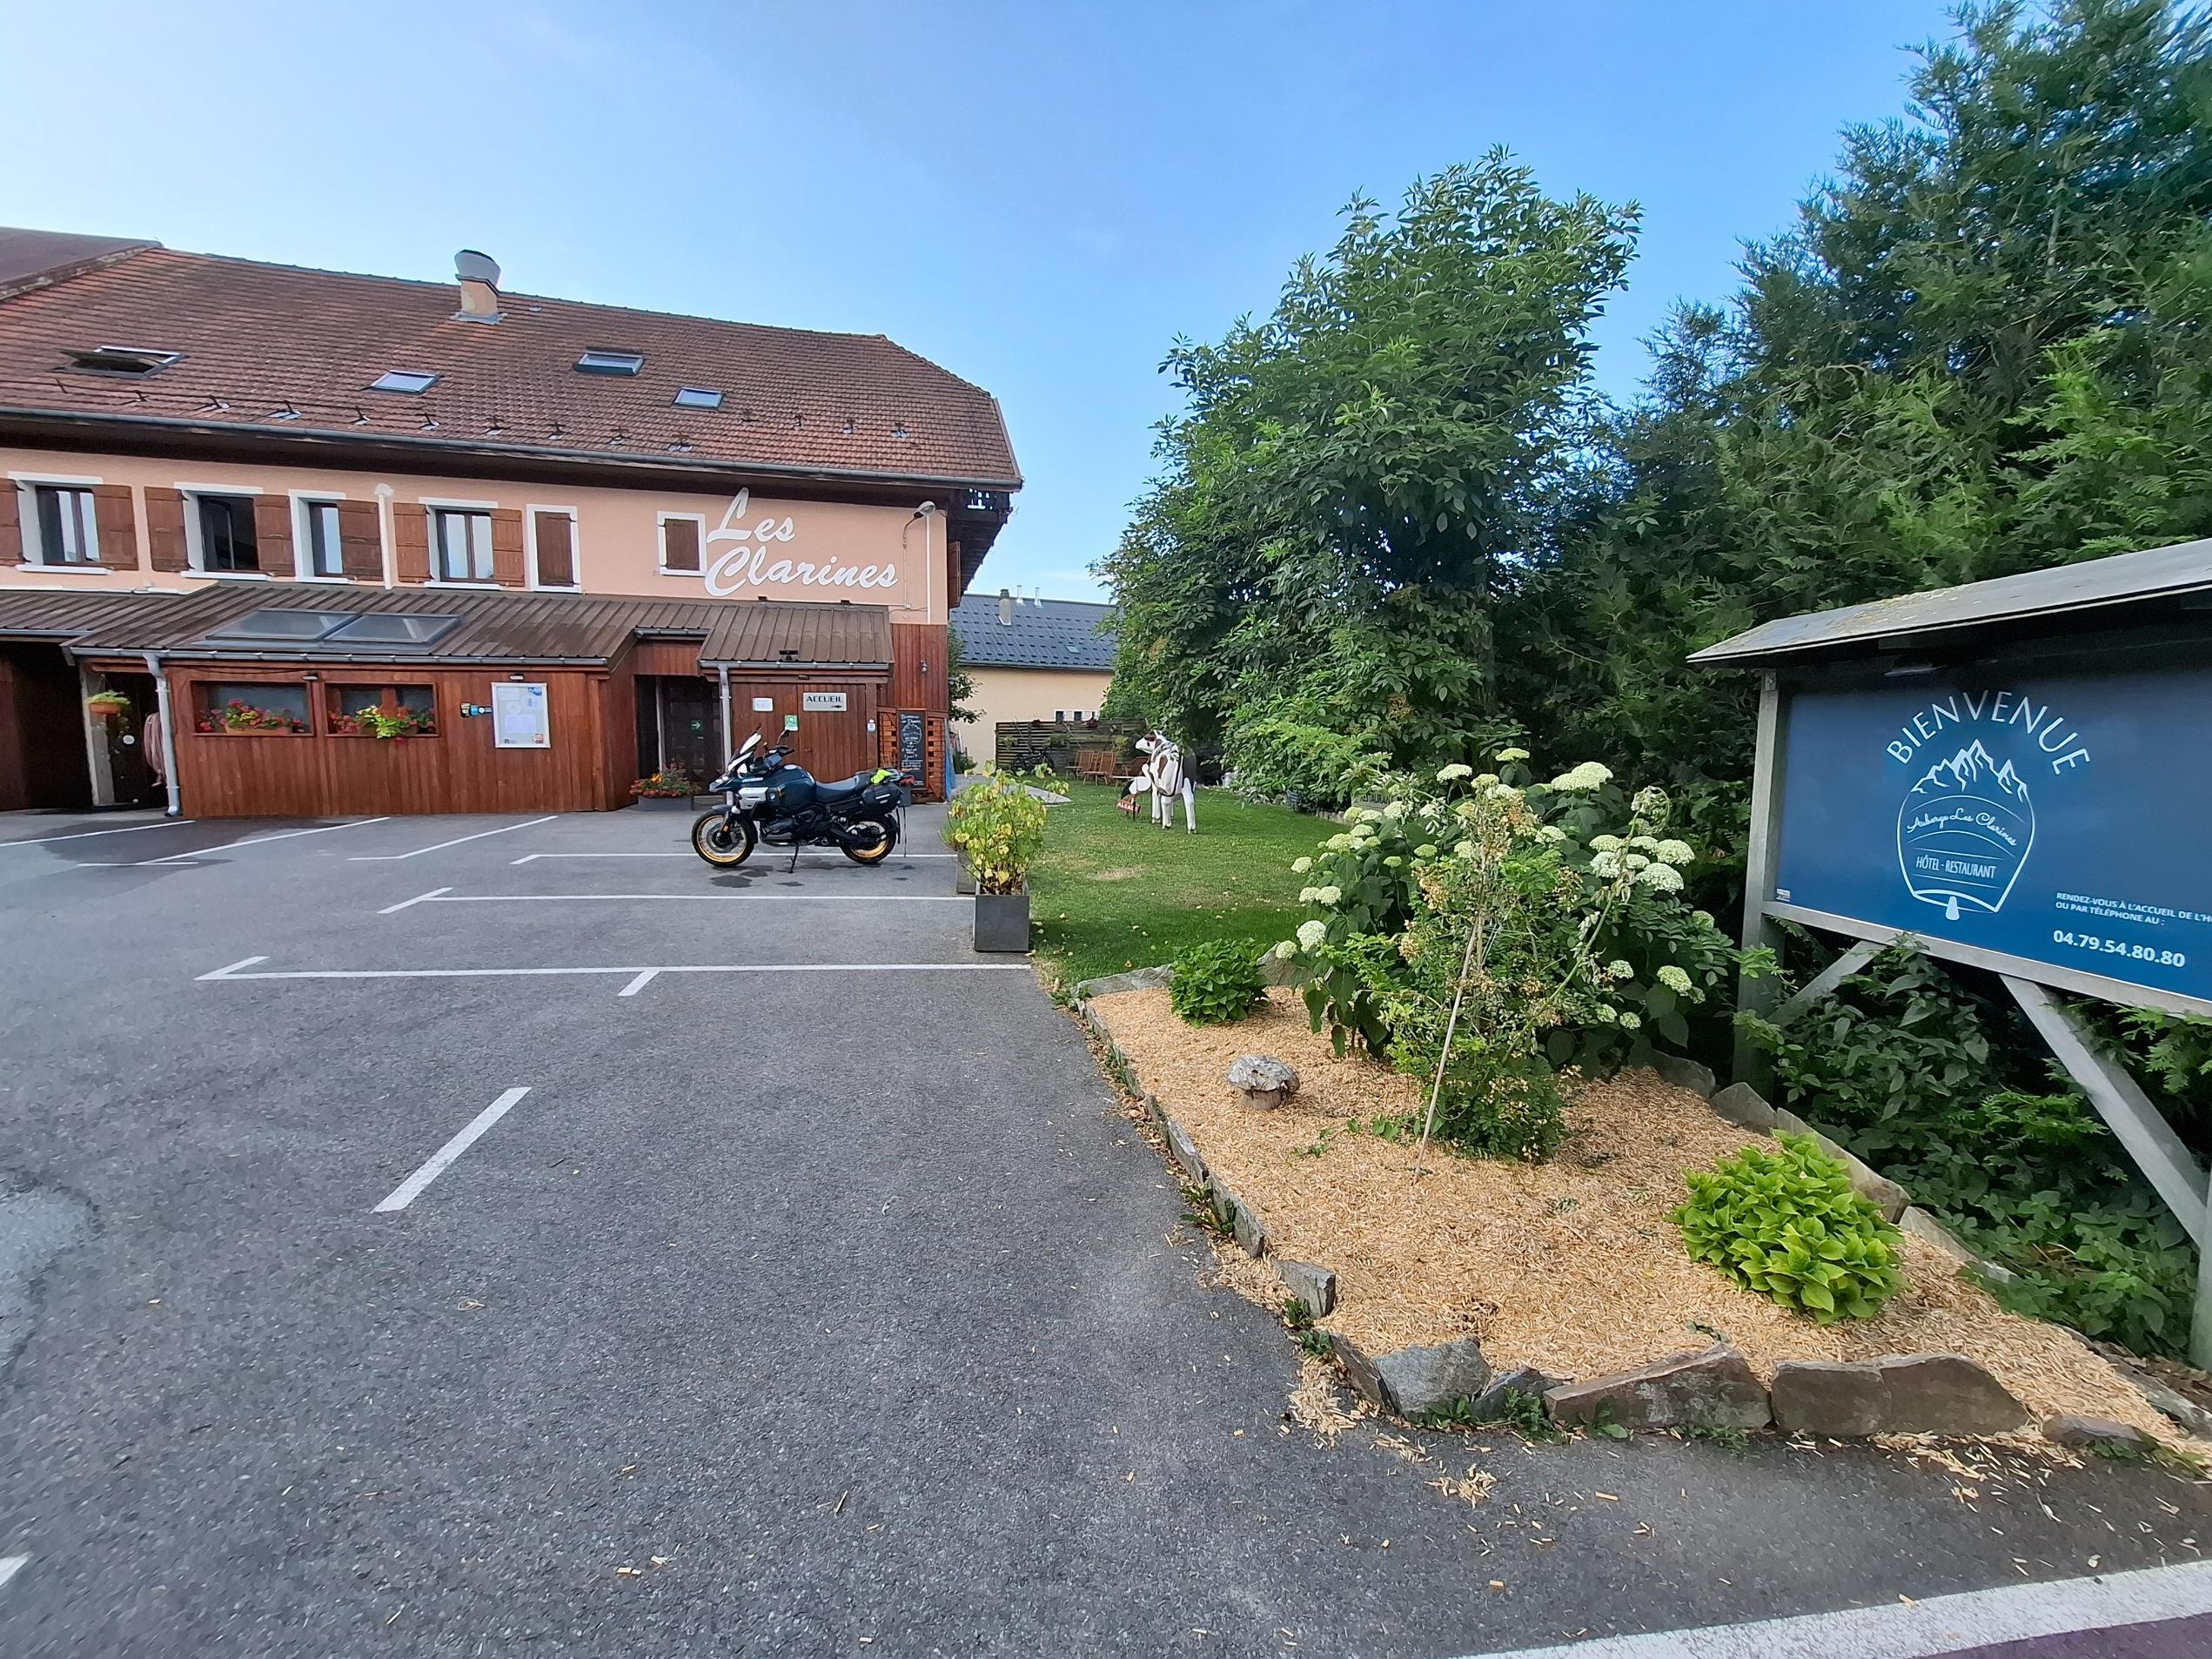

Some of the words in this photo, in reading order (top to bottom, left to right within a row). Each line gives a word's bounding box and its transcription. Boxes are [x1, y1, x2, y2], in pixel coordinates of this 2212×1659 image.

[706, 487, 795, 544] Les
[704, 546, 899, 596] Clarines
[1887, 689, 2091, 776] BIENVENUE
[1907, 813, 1948, 833] Auberge
[1949, 808, 1974, 822] Les
[1975, 812, 2017, 846] Clarines
[1915, 854, 1940, 871] HÔTEL
[1945, 859, 1997, 879] RESTAURANT
[2055, 901, 2069, 910] OU
[2070, 903, 2088, 913] PAR
[2089, 905, 2143, 923] TÉLÉPHONE
[2144, 916, 2159, 924] AU
[2056, 892, 2117, 909] RENDEZ-VOUS
[2119, 900, 2127, 910] À
[2128, 903, 2175, 917] L'ACCUEIL
[2178, 910, 2192, 920] DE
[2053, 930, 2186, 968] 04.79.54.80.80
